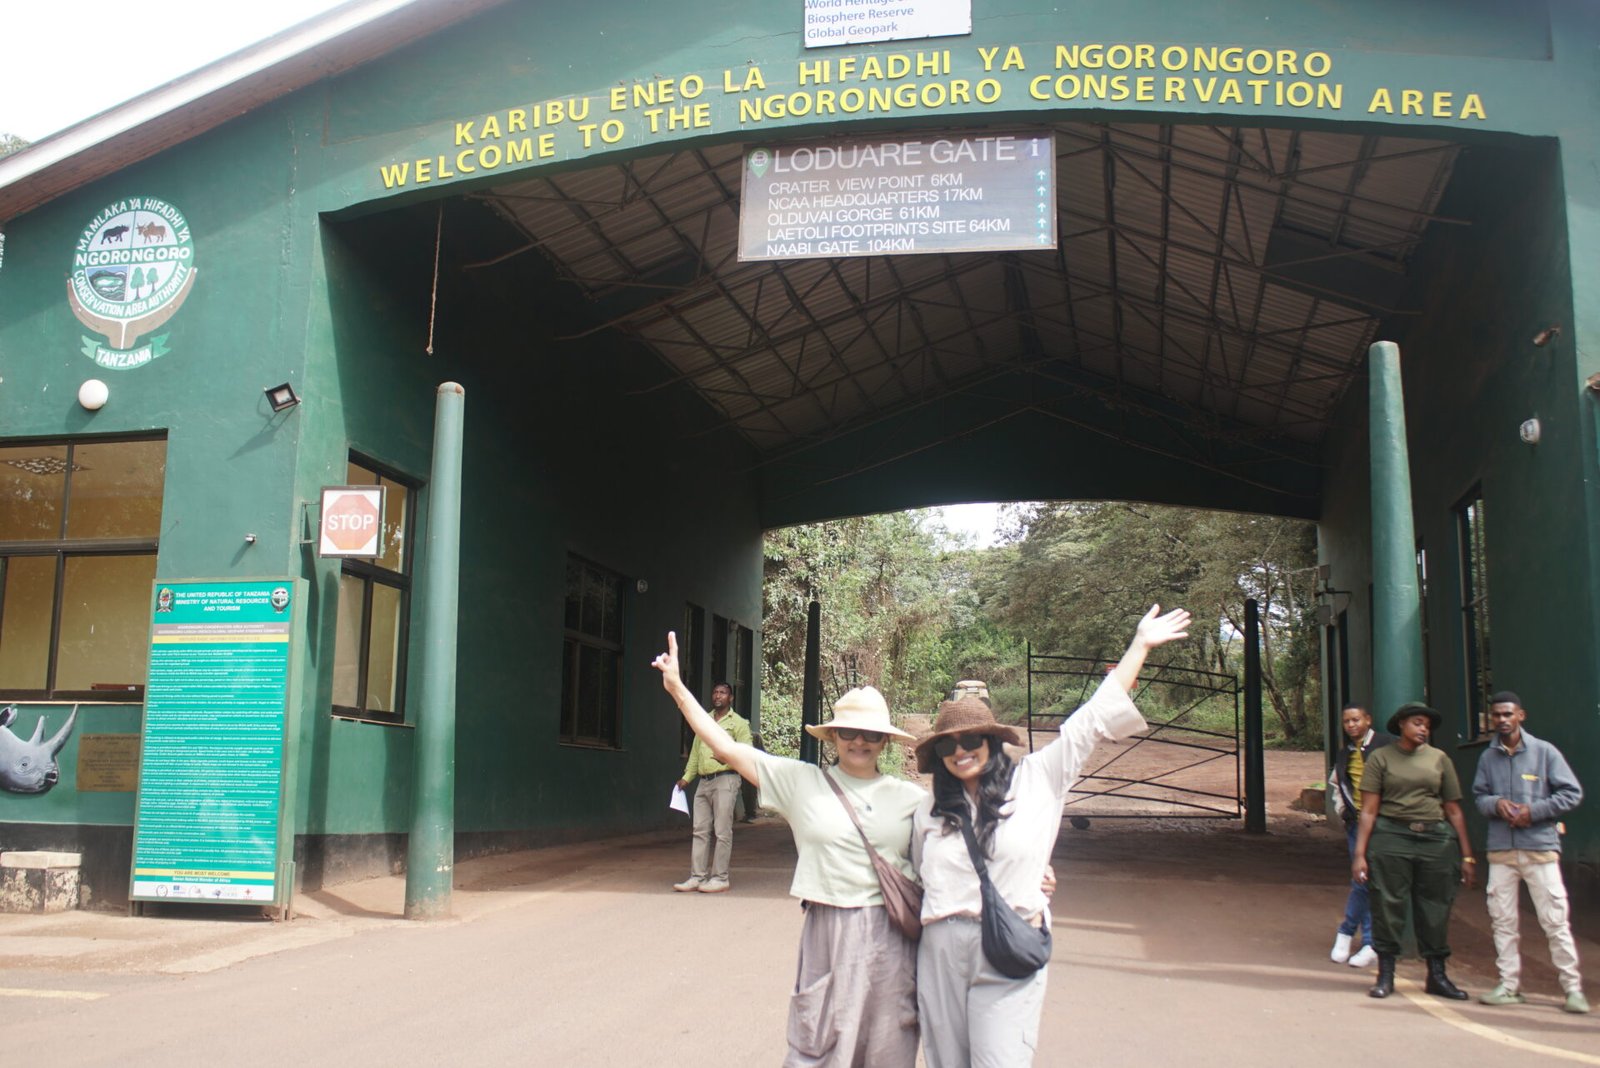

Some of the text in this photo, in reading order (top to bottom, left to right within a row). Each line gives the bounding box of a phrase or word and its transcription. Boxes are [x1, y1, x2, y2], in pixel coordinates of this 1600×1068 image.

[807, 6, 914, 25] Biosphere Reserve
[807, 22, 898, 39] Global Geopark
[455, 44, 1332, 145] KARIBU ENEO LA HIFADHI YA NGORONGORO
[380, 74, 1486, 189] WELCOME TO THE NGORONGORO CONSERVATION AREA
[774, 141, 922, 173] LODUARE
[929, 136, 1016, 165] GATE
[768, 173, 963, 196] CRATER VIEW POINT 6KM
[768, 188, 983, 211] NCAA HEADQUARTERS 17KM
[77, 198, 190, 252] MAMLAKA YA HIFADHI YA
[767, 205, 940, 226] OLDUVAI GORGE 61KM
[767, 218, 1010, 242] LAETOLI FOOTPRINTS SITE 64KM
[75, 246, 190, 267] NGORONGORO
[766, 238, 914, 257] NAABI GATE 104KM
[74, 262, 188, 317] CONSERVATION AREA AUTHORITY
[97, 347, 152, 368] TANZANIA
[327, 513, 375, 531] STOP
